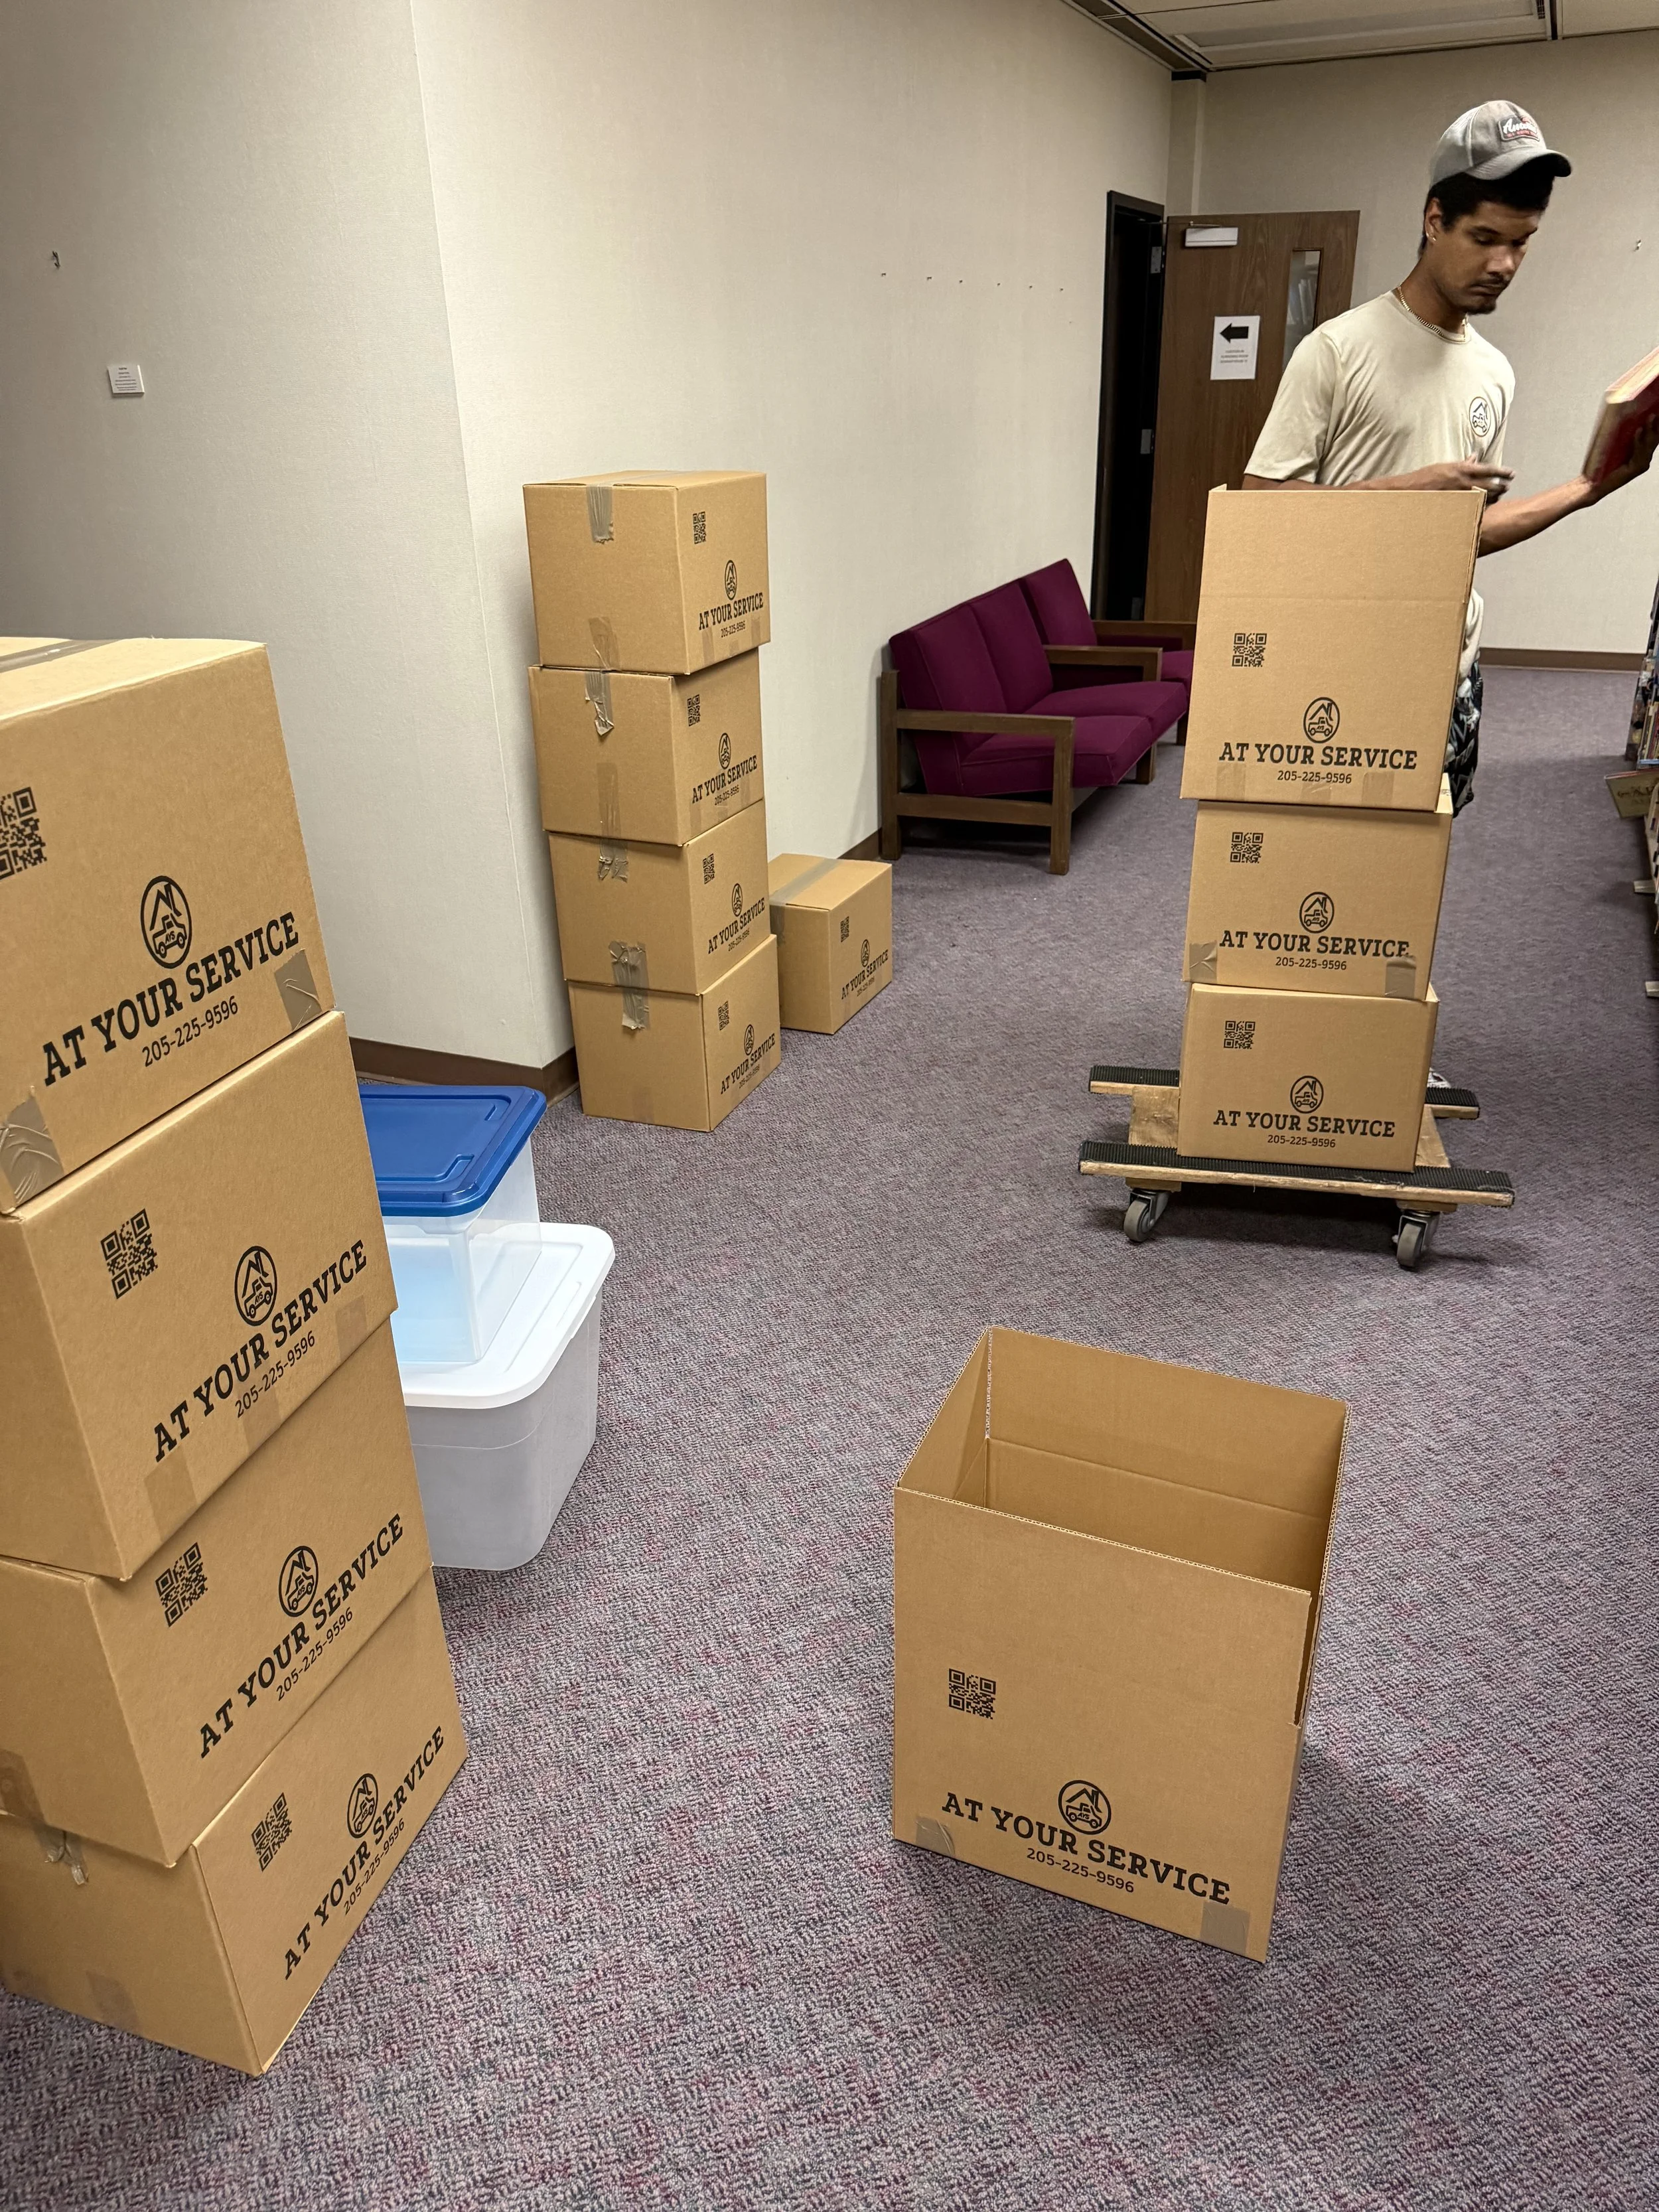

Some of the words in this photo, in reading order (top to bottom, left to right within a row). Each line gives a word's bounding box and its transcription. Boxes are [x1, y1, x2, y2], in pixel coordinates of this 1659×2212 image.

[699, 611, 709, 630] AT
[711, 604, 732, 625] YOUR
[733, 593, 763, 618] SERVICE
[692, 784, 703, 804] AT
[704, 773, 726, 796] YOUR
[727, 755, 757, 784] SERVICE
[1219, 743, 1249, 761] AT
[1255, 743, 1314, 765] YOUR
[1321, 746, 1417, 769] SERVICE
[1277, 771, 1352, 784] 205-225-9596
[709, 934, 717, 954] AT
[719, 920, 739, 944] YOUR
[740, 897, 764, 929] SERVICE
[1220, 930, 1248, 948] AT
[1254, 932, 1310, 952] YOUR
[1317, 936, 1409, 958] SERVICE
[841, 983, 849, 999] AT
[850, 969, 866, 991] YOUR
[867, 949, 889, 977] SERVICE
[1275, 957, 1346, 970] 205-225-9596
[43, 1025, 86, 1086] AT
[91, 978, 183, 1053] YOUR
[186, 912, 299, 1002] SERVICE
[142, 995, 238, 1067] 205-225-9596
[721, 1075, 730, 1094] AT
[731, 1059, 749, 1084] YOUR
[751, 1033, 775, 1067] SERVICE
[1213, 1110, 1240, 1126] AT
[1246, 1112, 1301, 1131] YOUR
[1307, 1116, 1395, 1138] SERVICE
[1267, 1135, 1335, 1147] 205-225-9596
[155, 1403, 190, 1462] AT
[193, 1333, 269, 1417] YOUR
[272, 1240, 366, 1348] SERVICE
[235, 1331, 315, 1418] 205-225-9596
[200, 1700, 234, 1758] AT
[238, 1622, 309, 1708] YOUR
[313, 1514, 403, 1630] SERVICE
[277, 1607, 352, 1701] 205-225-9596
[285, 1923, 310, 1980] AT
[315, 1841, 370, 1927] YOUR
[373, 1726, 443, 1845] SERVICE
[344, 1818, 404, 1915] 205-225-9596
[942, 1793, 983, 1822] AT
[991, 1806, 1078, 1855] YOUR
[1088, 1840, 1230, 1905] SERVICE
[1027, 1848, 1133, 1893] 205-225-9596
